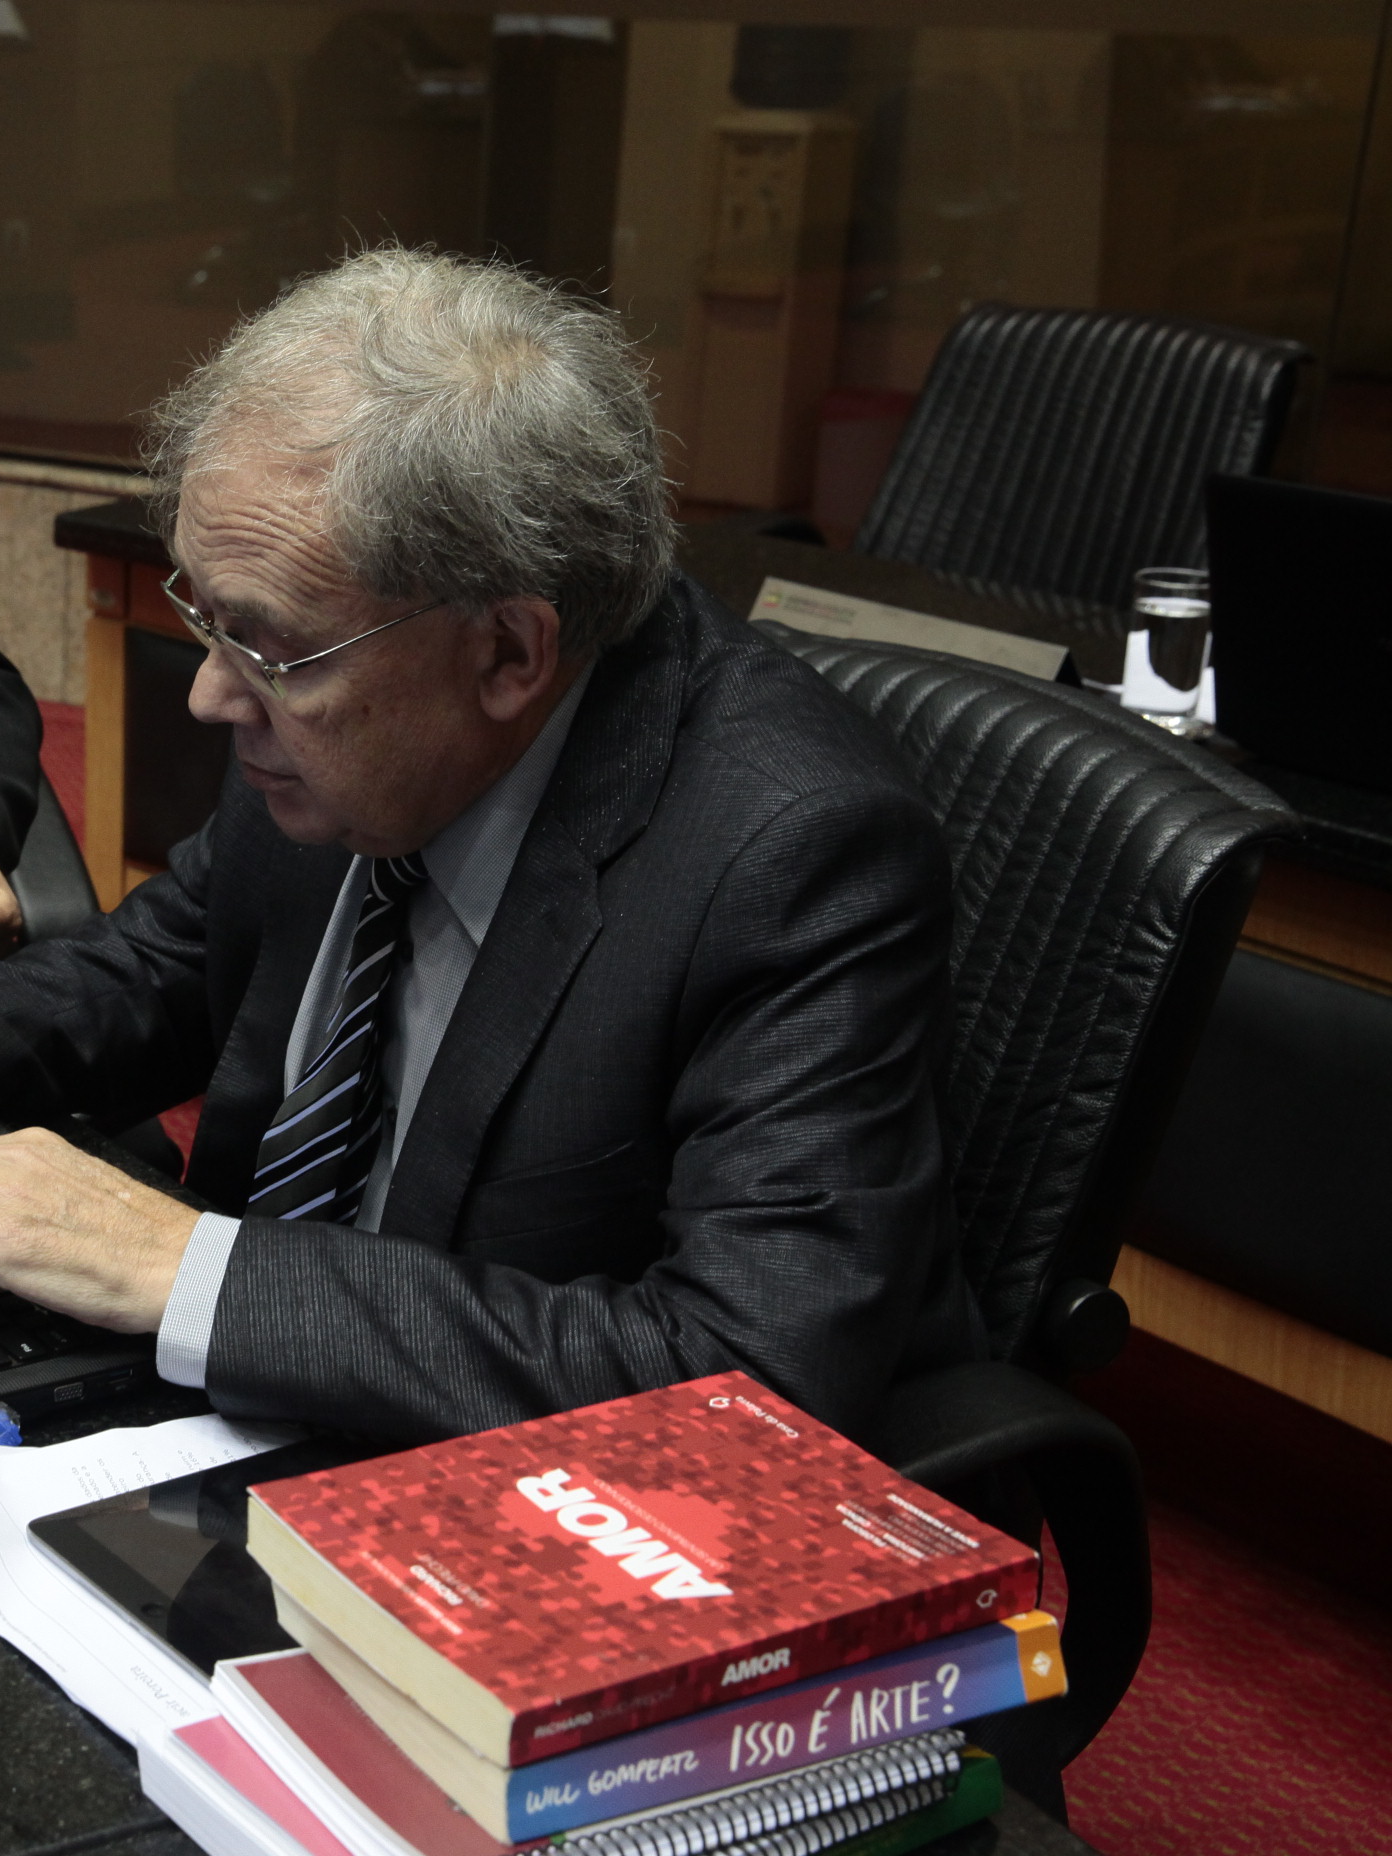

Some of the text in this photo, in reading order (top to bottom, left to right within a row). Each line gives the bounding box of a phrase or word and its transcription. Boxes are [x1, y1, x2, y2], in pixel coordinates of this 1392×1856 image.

[734, 1395, 767, 1418] Palavra
[776, 1422, 800, 1439] Casa
[516, 1467, 734, 1600] AMOR
[534, 1711, 594, 1739] RICHARD
[720, 1647, 792, 1687] AMOR
[525, 1782, 581, 1815] WILL
[587, 1750, 700, 1796] GOMPERTZ
[729, 1720, 796, 1773] ISSO
[808, 1686, 842, 1754] É
